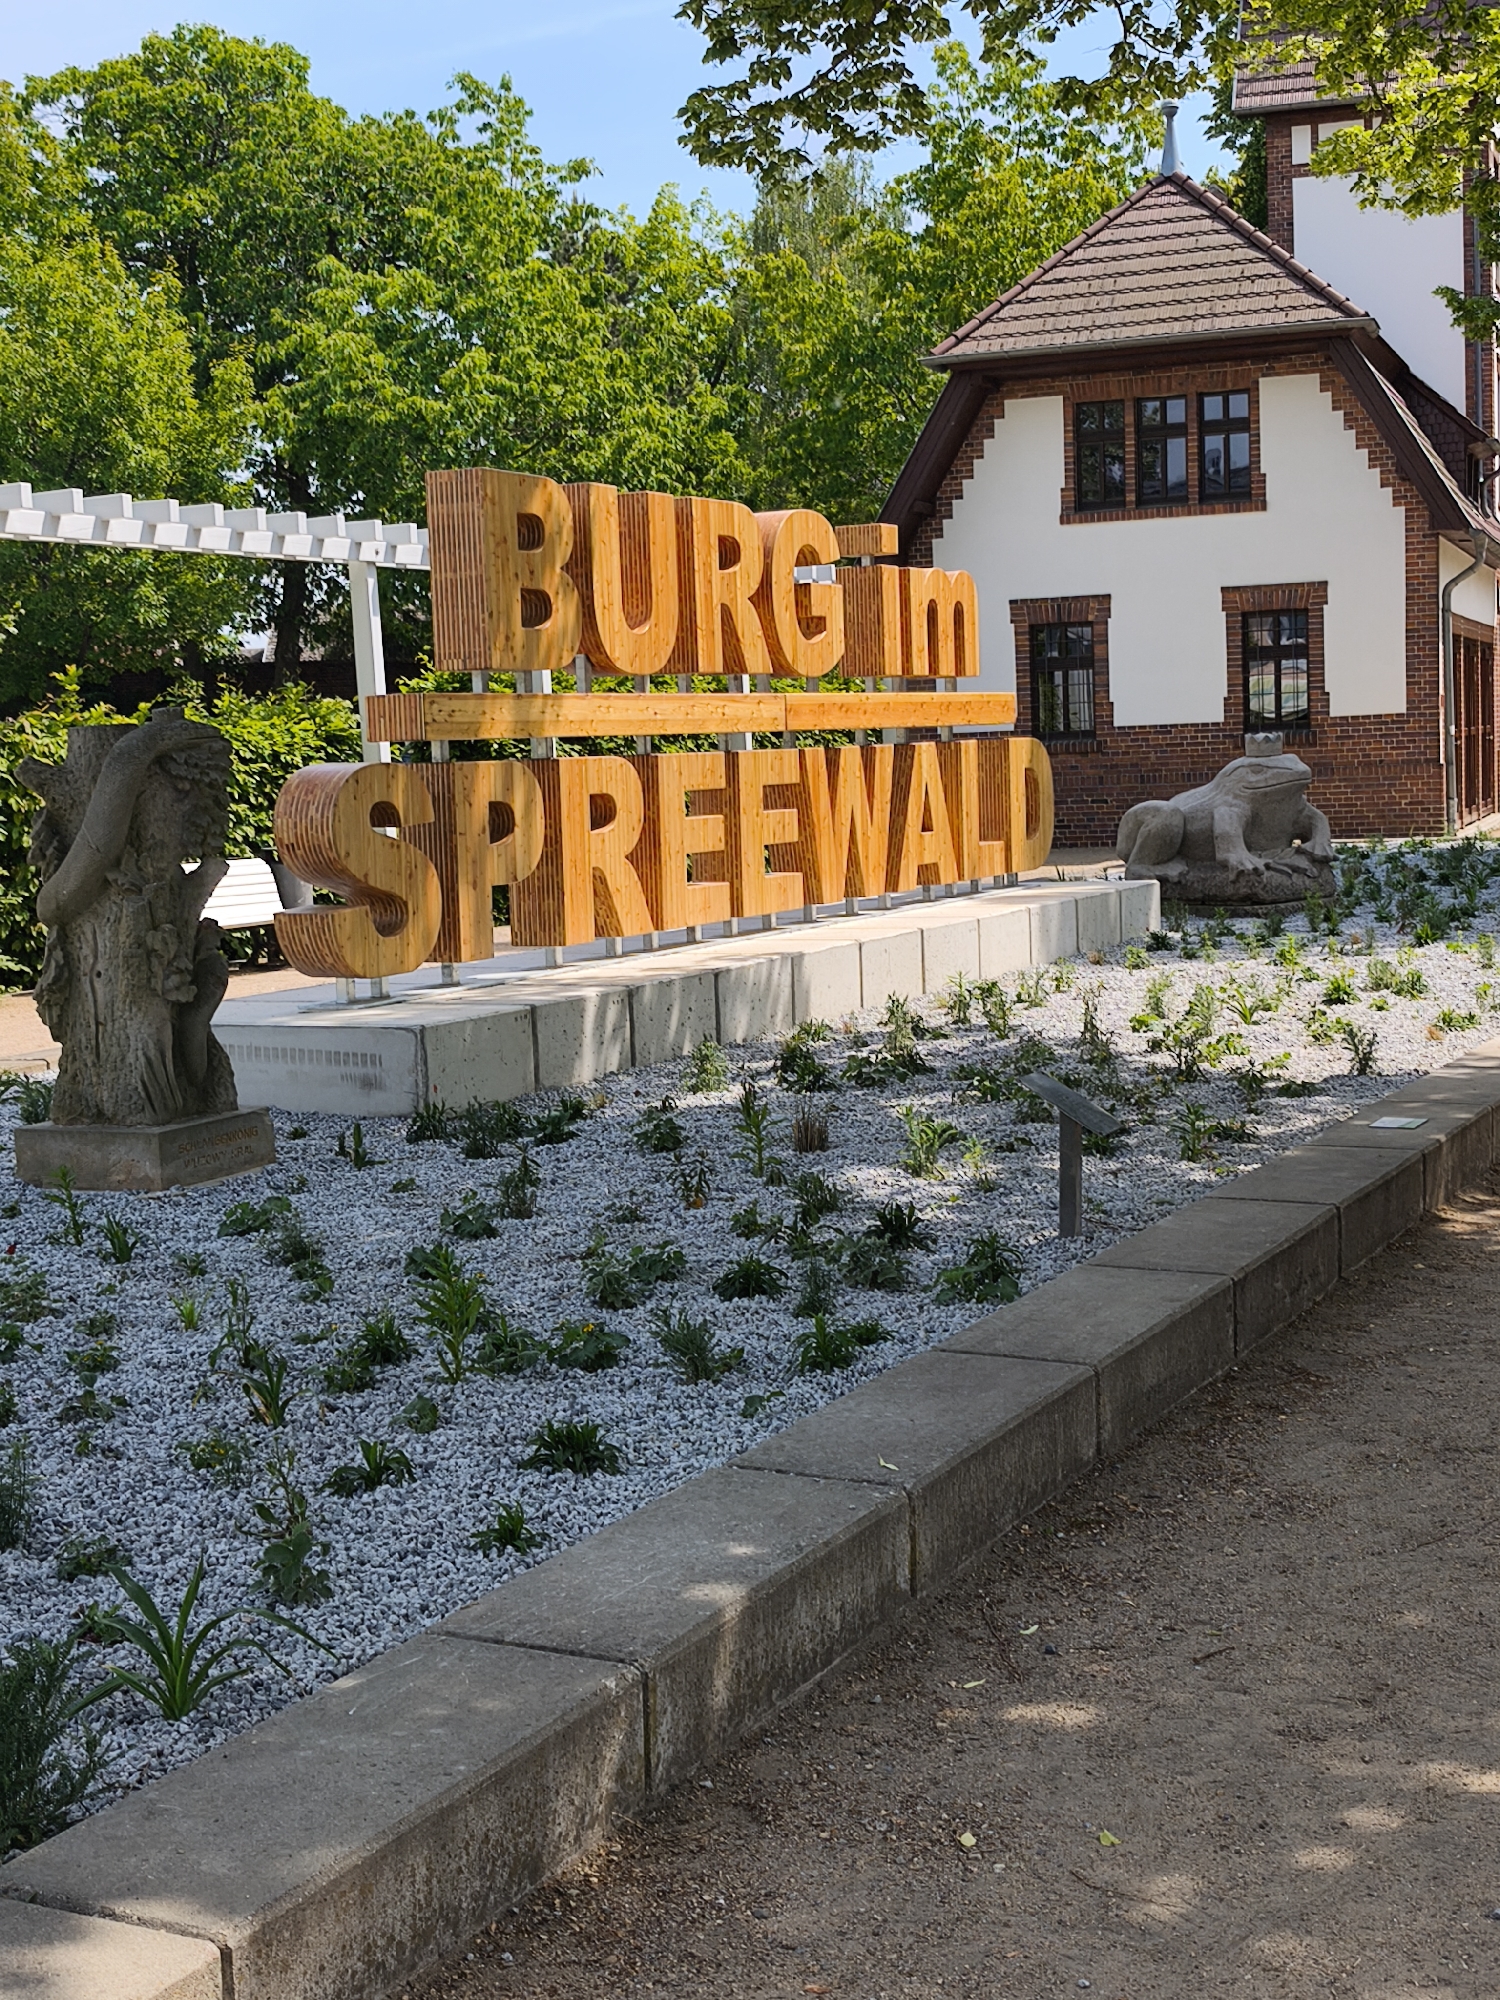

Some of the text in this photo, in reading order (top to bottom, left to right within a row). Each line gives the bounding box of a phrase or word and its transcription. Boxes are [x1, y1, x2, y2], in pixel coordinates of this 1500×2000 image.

[426, 467, 980, 678] BURG im
[274, 737, 1055, 979] SPREEWALD
